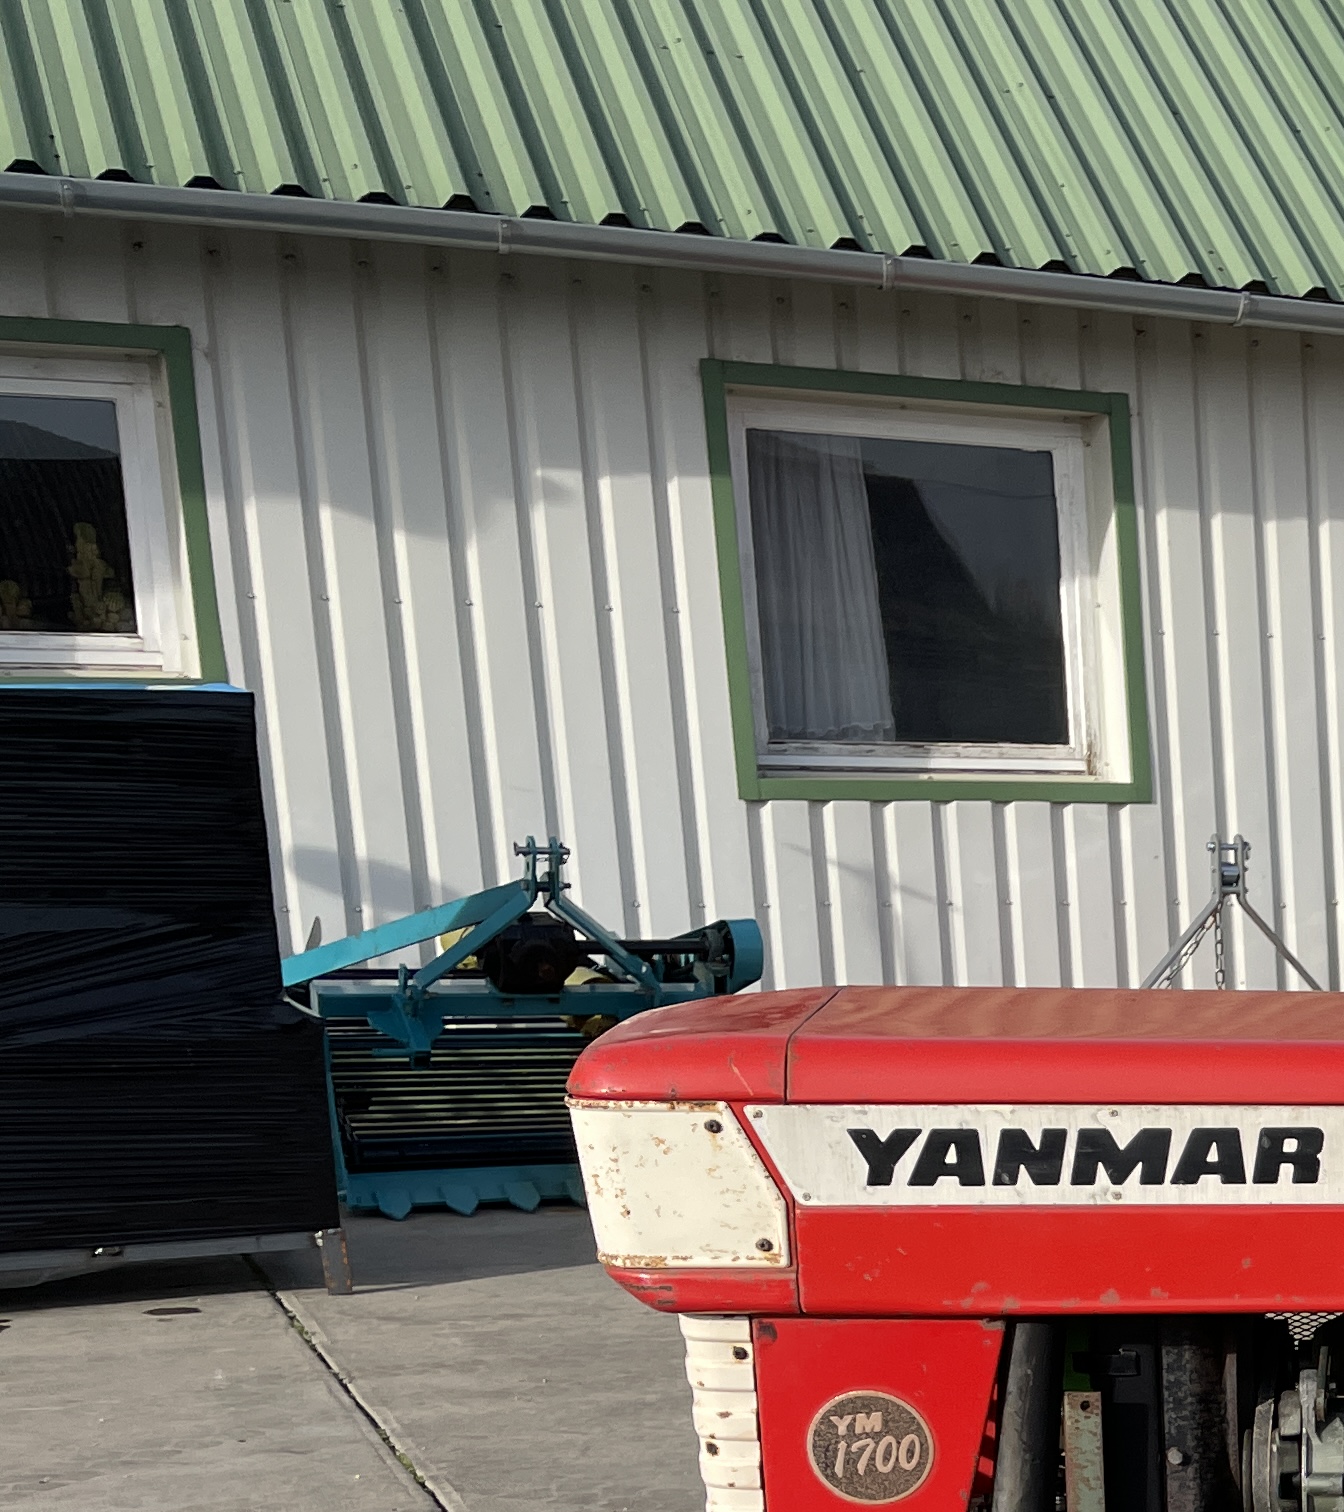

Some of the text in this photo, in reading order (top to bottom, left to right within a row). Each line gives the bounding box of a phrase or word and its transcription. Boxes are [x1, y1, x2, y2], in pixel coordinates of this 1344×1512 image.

[847, 1126, 1325, 1187] YANMAR
[829, 1411, 883, 1436] YM
[834, 1433, 921, 1478] 1700
